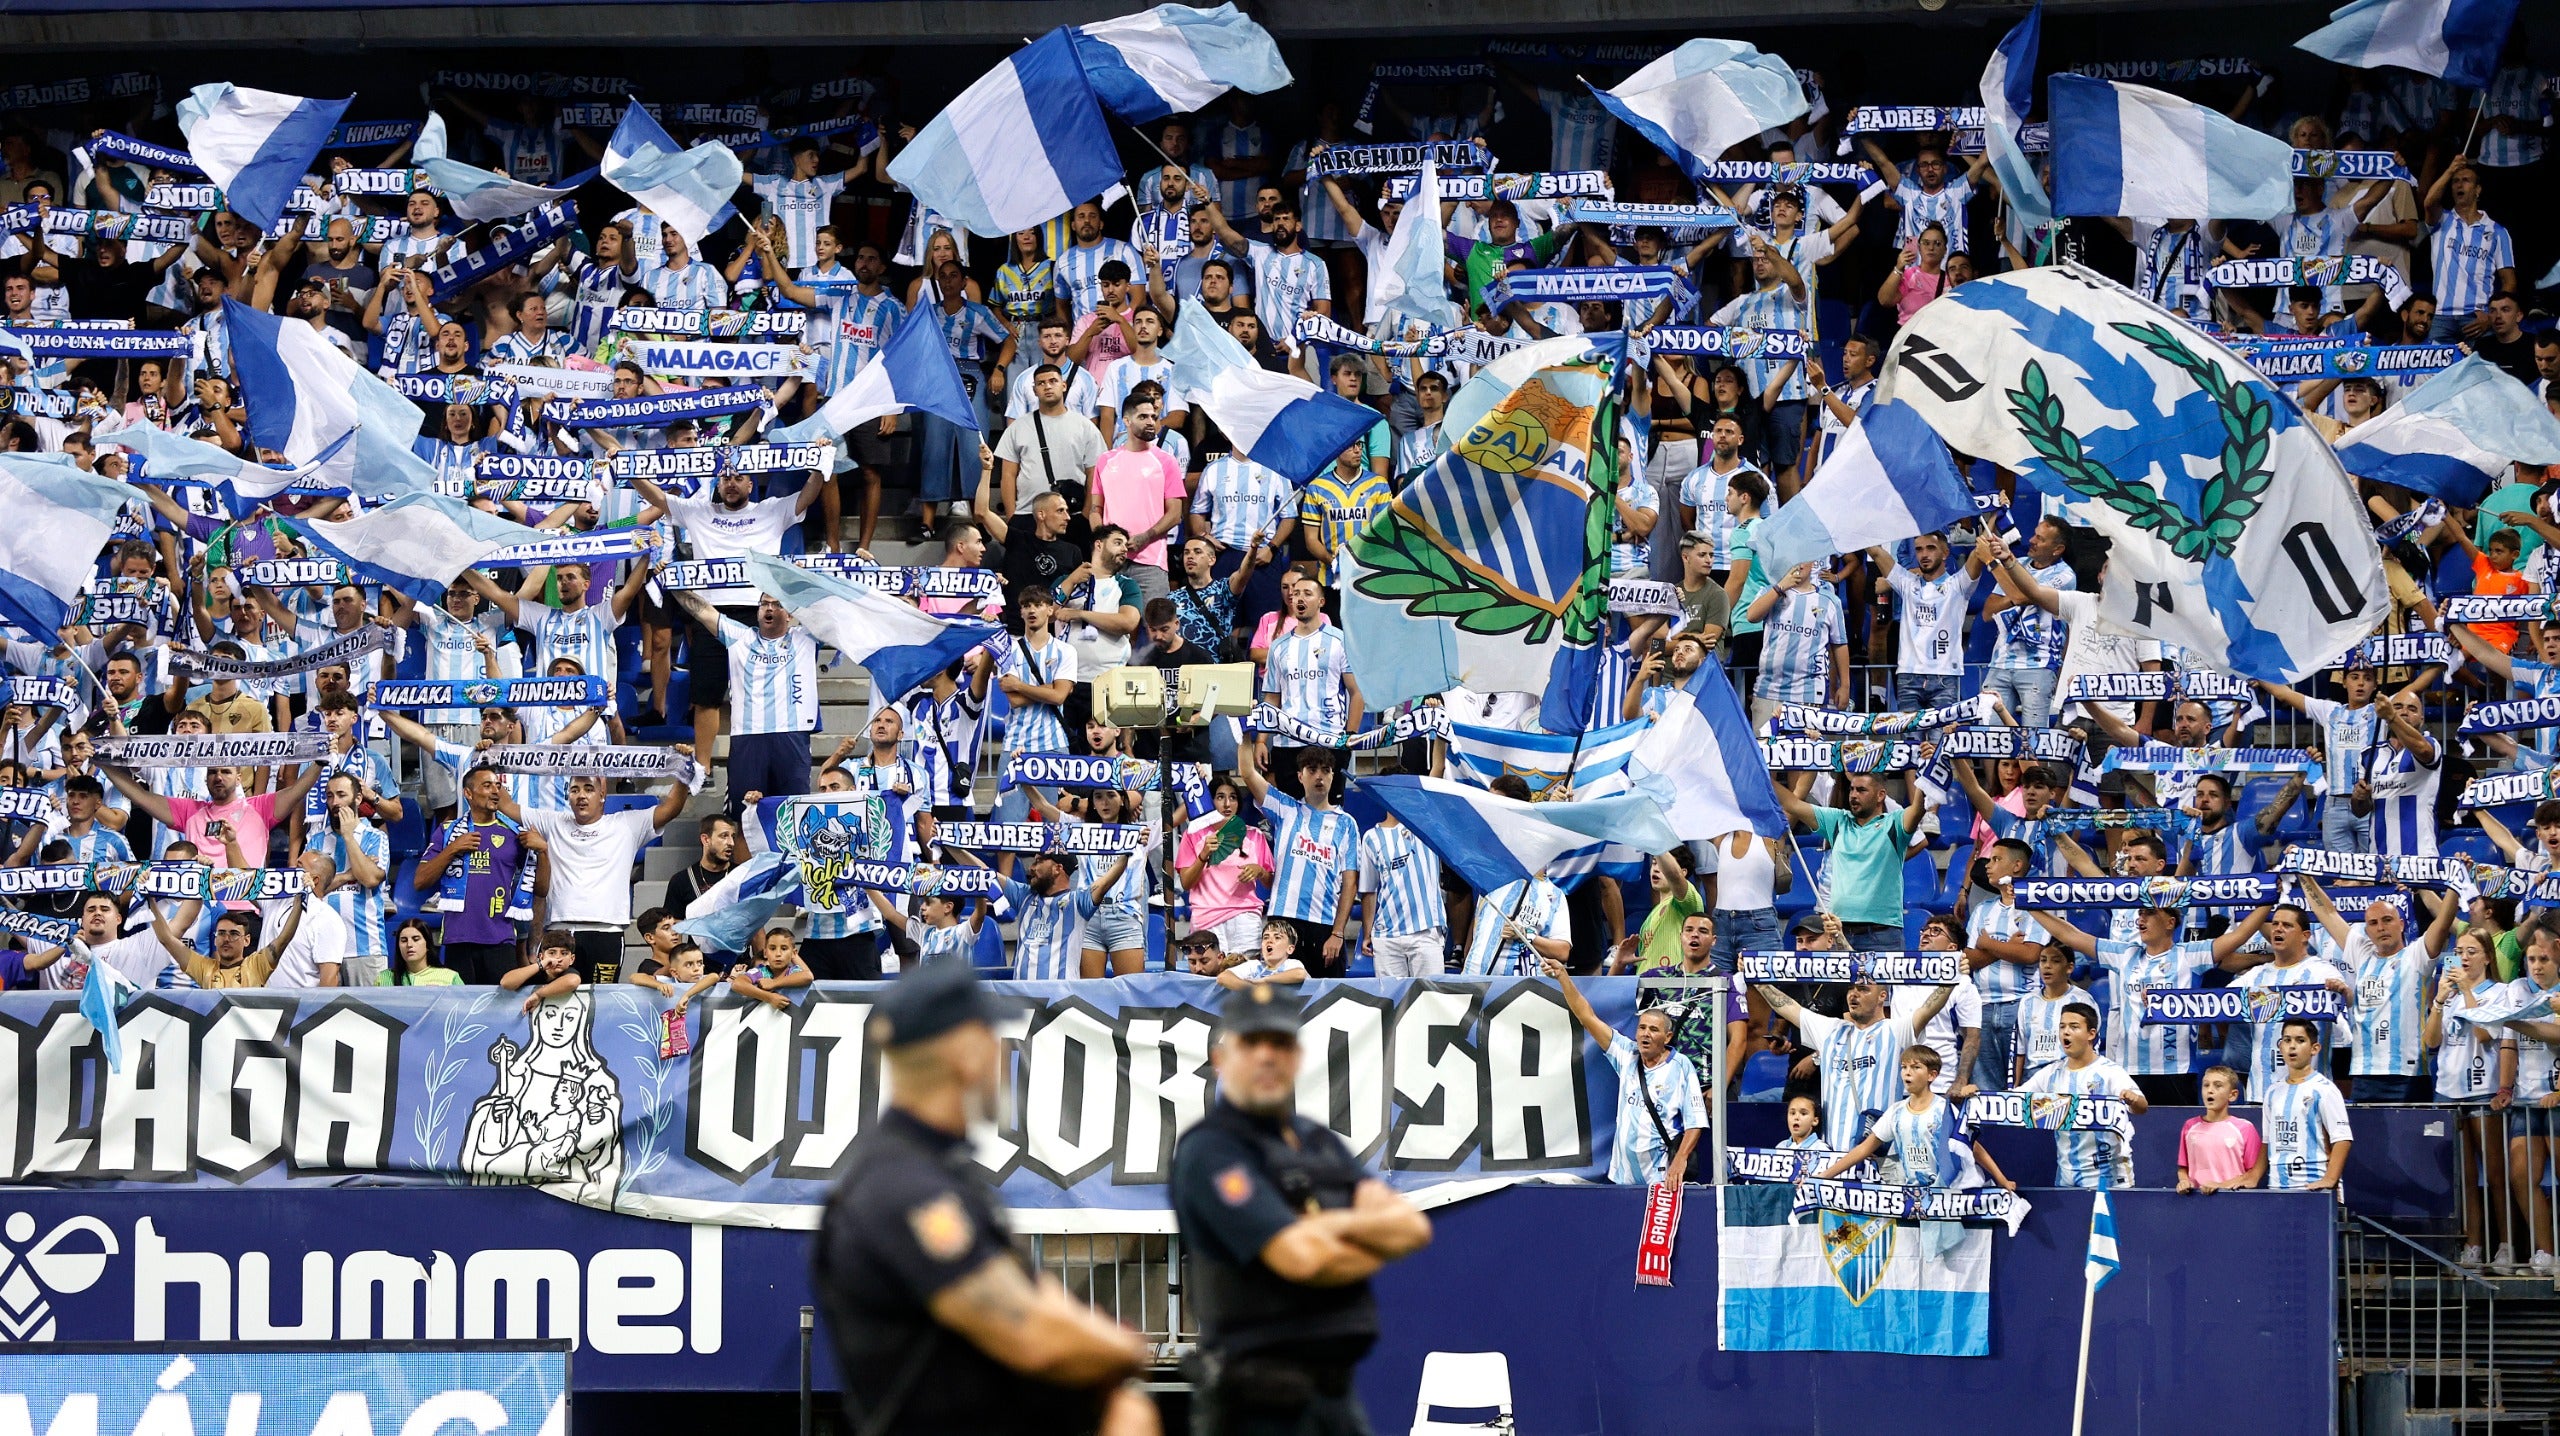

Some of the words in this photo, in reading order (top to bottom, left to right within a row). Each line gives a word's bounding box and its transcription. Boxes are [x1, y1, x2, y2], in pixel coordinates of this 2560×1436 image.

[15, 82, 90, 106] PADRES
[436, 71, 530, 90] FONDO
[573, 75, 630, 95] SUR
[562, 107, 586, 125] DE
[1858, 109, 1937, 128] PADRES
[346, 123, 411, 143] HINCHAS
[1812, 163, 1862, 180] SUR
[2340, 154, 2395, 176] SUR
[1539, 174, 1601, 194] SUR
[778, 200, 822, 213] málaga
[1581, 199, 1733, 216] ARCHIDONA
[133, 218, 186, 239] SUR
[1536, 273, 1648, 295] MALAGA
[1007, 291, 1046, 302] MALAGA
[612, 310, 700, 333] FONDO
[754, 311, 806, 334] SUR
[842, 322, 873, 339] Tivoli
[68, 335, 106, 351] UNA
[110, 335, 180, 350] GITANA
[2256, 355, 2323, 377] MALAKA
[2377, 349, 2452, 370] HINCHAS
[536, 377, 565, 389] CLUB
[566, 379, 580, 390] DE
[12, 392, 75, 417] MALAGA
[658, 399, 695, 413] UNA
[700, 390, 765, 409] GITANA
[480, 456, 584, 478] FONDO
[635, 452, 716, 475] PADRES
[760, 445, 821, 468] HIJOS
[523, 480, 588, 499] SUR
[1221, 492, 1266, 505] málaga
[1329, 507, 1368, 521] MALAGA
[496, 536, 607, 560] MALAGA
[1608, 586, 1668, 605] OSALEDA
[2448, 598, 2544, 619] FONDO
[1773, 620, 1819, 638] málaga
[202, 654, 248, 673] HIJOS
[252, 661, 272, 674] DE
[276, 660, 293, 674] LA
[297, 632, 369, 668] ROSALEDA
[1937, 629, 1948, 655] Olin
[1286, 669, 1325, 681] málaga
[2085, 674, 2165, 697] PADRES
[380, 686, 452, 705] MALAKA
[508, 681, 586, 703] HINCHAS
[1396, 708, 1450, 738] SUR
[2463, 700, 2560, 728] FONDO
[122, 740, 167, 759] HIJOS
[171, 741, 193, 758] DE
[196, 740, 215, 757] LA
[220, 739, 295, 757] ROSALEDA
[1950, 731, 2012, 754] ADRES
[500, 750, 543, 768] HIJOS
[547, 751, 568, 767] DE
[571, 752, 589, 767] LA
[591, 752, 667, 770] ROSALEDA
[1008, 758, 1113, 783] FONDO
[2463, 771, 2544, 803] FONDO
[1, 791, 52, 819] SUR
[960, 825, 1045, 847] PADRES
[1292, 849, 1310, 859] COSTA
[1311, 855, 1323, 863] DEL
[2301, 852, 2377, 877] PADRES
[140, 871, 200, 896] NDO
[943, 869, 997, 892] SUR
[2027, 881, 2139, 903] FONDO
[2191, 876, 2263, 898] SUR
[1744, 956, 1771, 979] DE
[1773, 956, 1851, 980] PADRES
[1891, 957, 1957, 980] HIJOS
[2146, 995, 2242, 1020] FONDO
[2286, 989, 2341, 1015] SUR
[2379, 1019, 2389, 1042] Olin
[1819, 1192, 1905, 1215] PADRES
[1953, 1194, 2011, 1216] HIJOS
[135, 1215, 723, 1355] hummel
